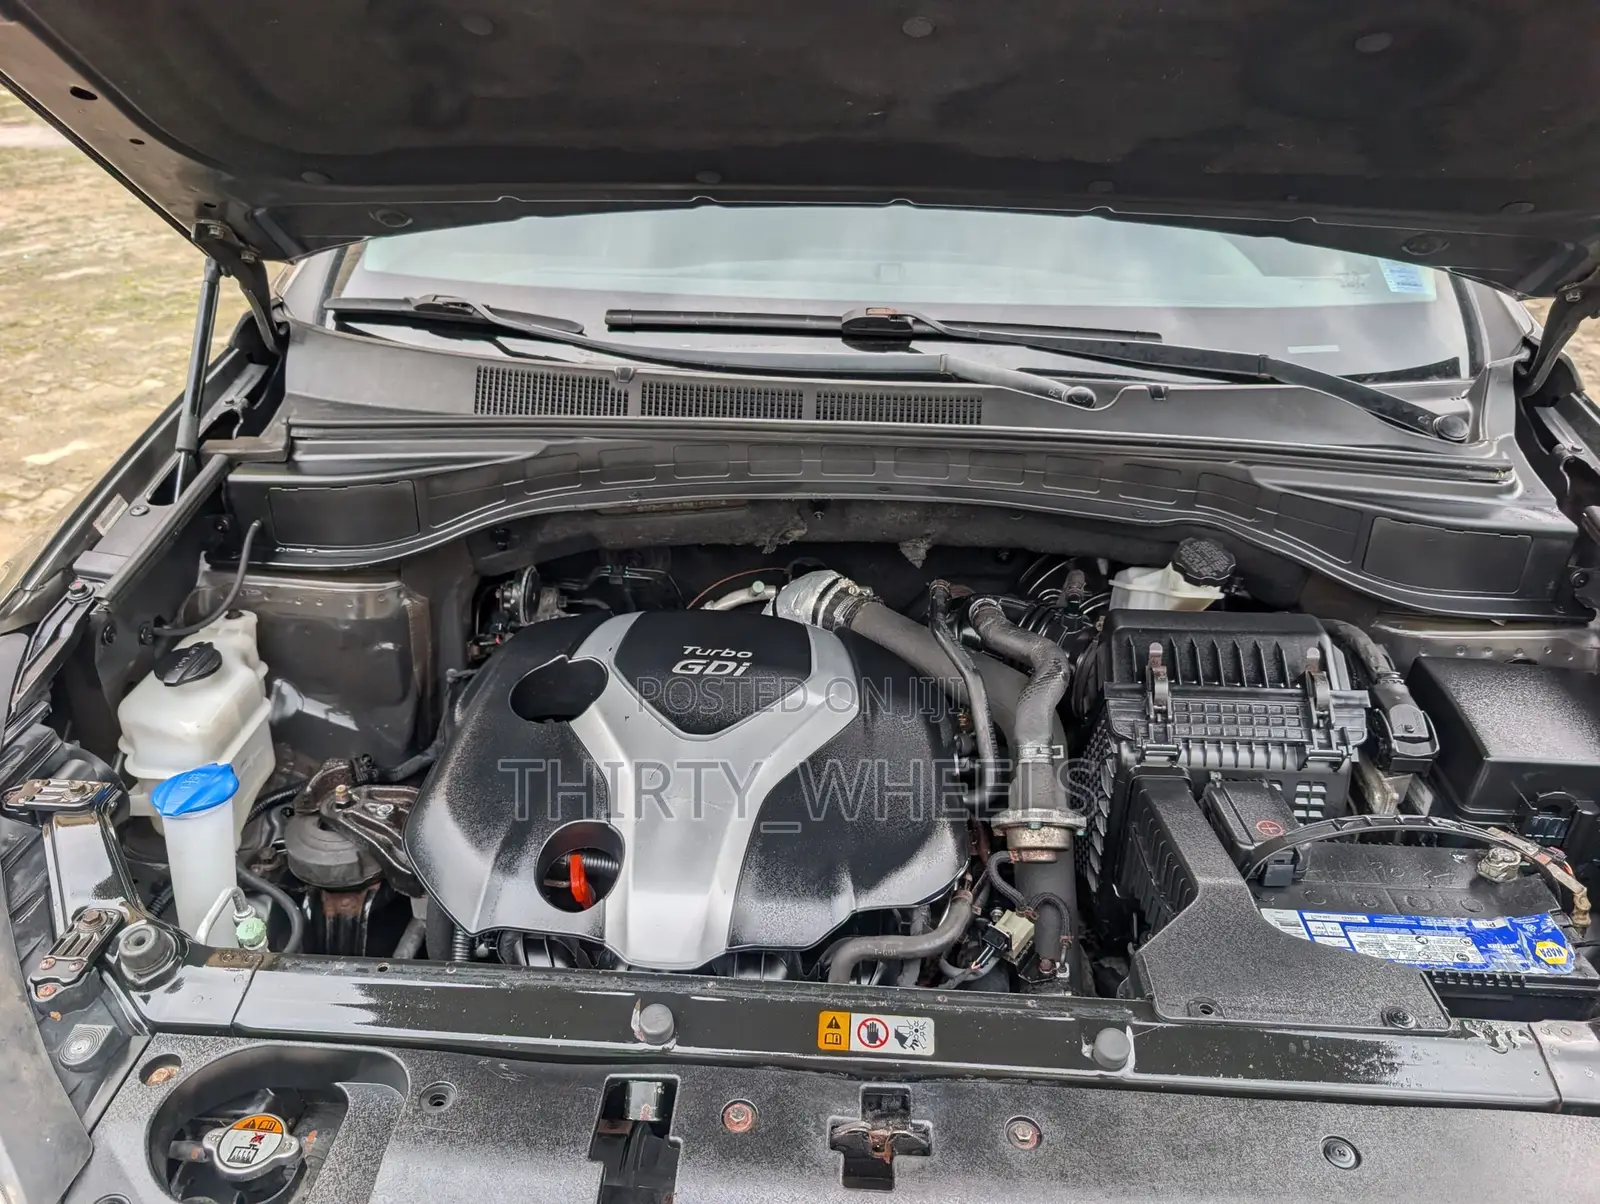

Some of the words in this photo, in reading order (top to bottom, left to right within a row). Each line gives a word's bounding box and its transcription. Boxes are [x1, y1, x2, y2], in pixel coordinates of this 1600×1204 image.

[683, 645, 753, 658] Turbo
[672, 659, 752, 677] GDi
[1540, 946, 1563, 958] NAPA
